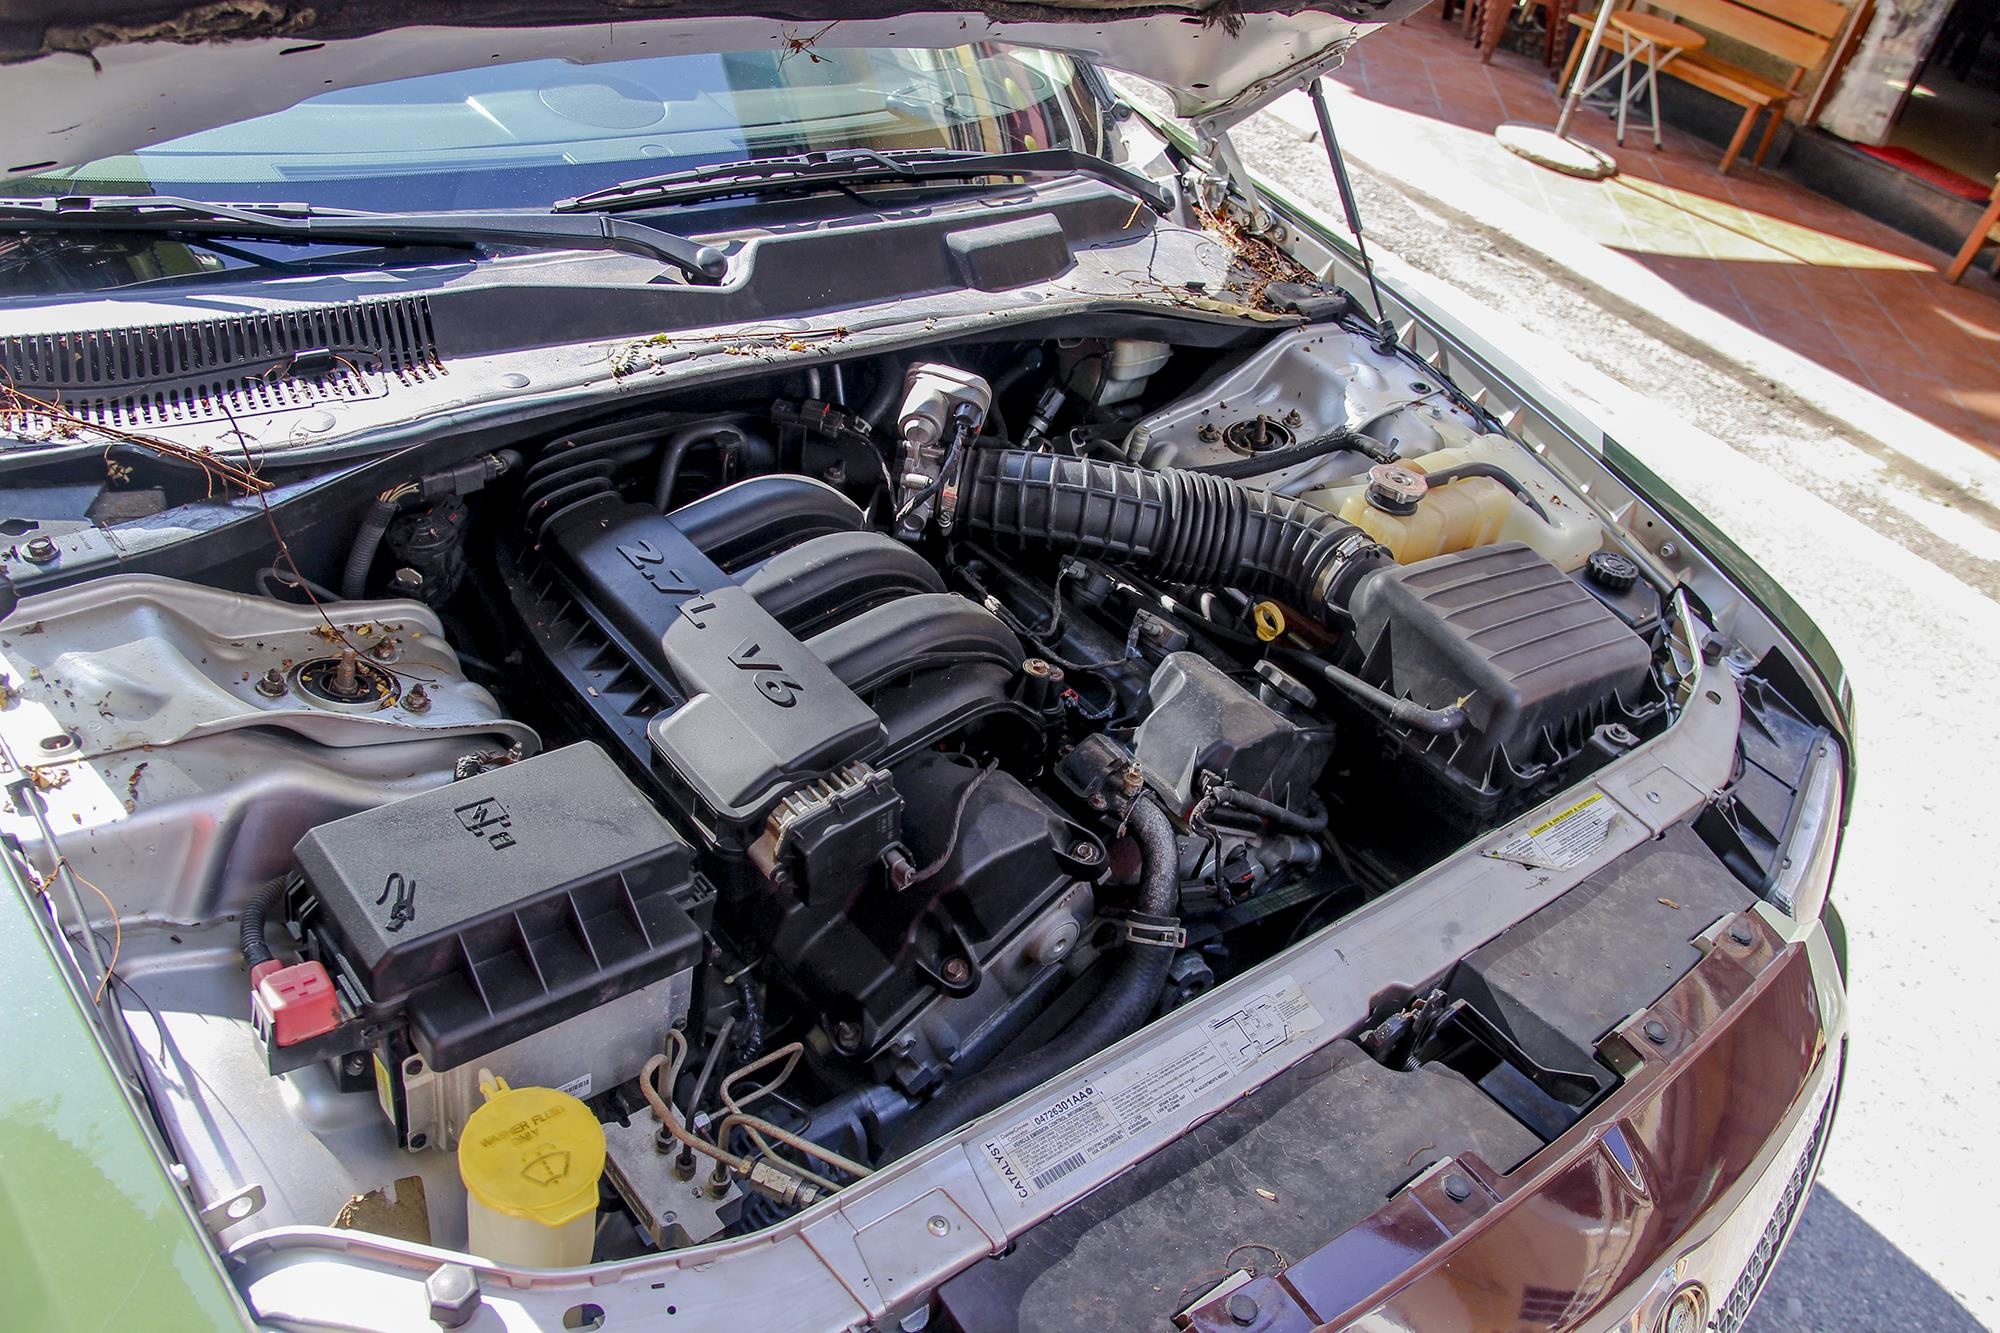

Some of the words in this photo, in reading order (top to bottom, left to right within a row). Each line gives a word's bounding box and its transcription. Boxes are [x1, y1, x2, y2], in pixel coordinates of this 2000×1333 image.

[728, 636, 804, 708] V6
[480, 1120, 530, 1148] WASHER
[532, 1105, 566, 1126] FLUID
[1013, 1136, 1030, 1148] VEHICLE
[1030, 1126, 1049, 1138] EMISSION
[1049, 1115, 1067, 1128] CONTROL
[1066, 1101, 1093, 1118] INFORMATION
[1034, 1090, 1089, 1125] 04726301AA
[986, 1142, 1028, 1198] CATALYST
